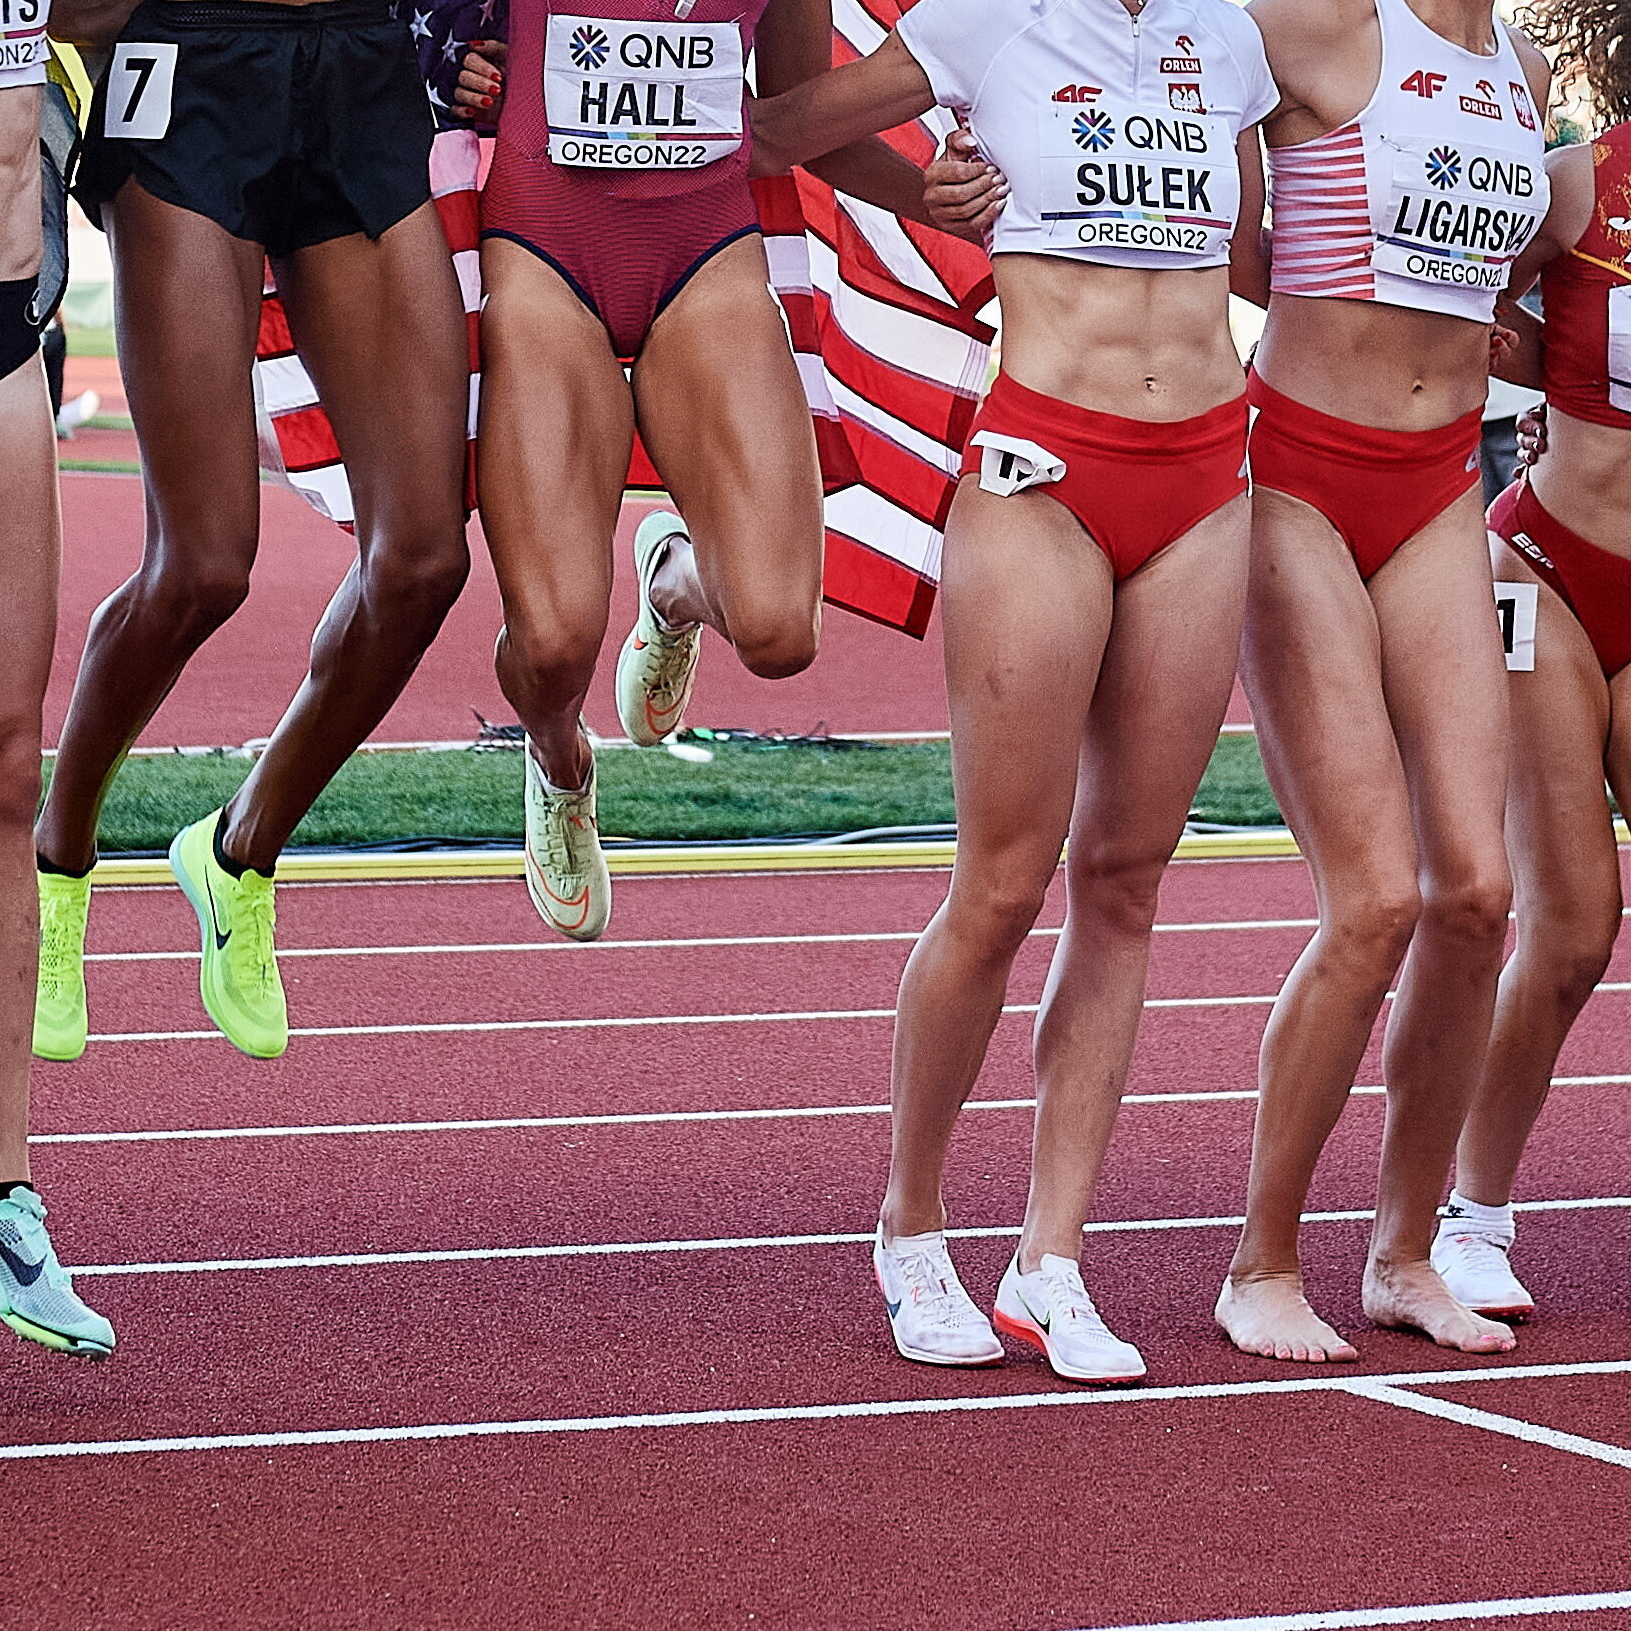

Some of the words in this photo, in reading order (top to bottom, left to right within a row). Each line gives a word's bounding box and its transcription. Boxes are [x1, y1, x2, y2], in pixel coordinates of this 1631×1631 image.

[620, 34, 714, 69] QNB
[1162, 59, 1200, 72] ORLEN
[122, 58, 157, 123] 7
[580, 81, 697, 127] HALL
[1461, 101, 1500, 118] ORLEN
[1124, 116, 1208, 153] QNB
[561, 142, 707, 165] OREGON22
[1076, 163, 1212, 213] SUŁEK
[1468, 157, 1533, 197] QNB
[1078, 224, 1208, 250] OREGON22
